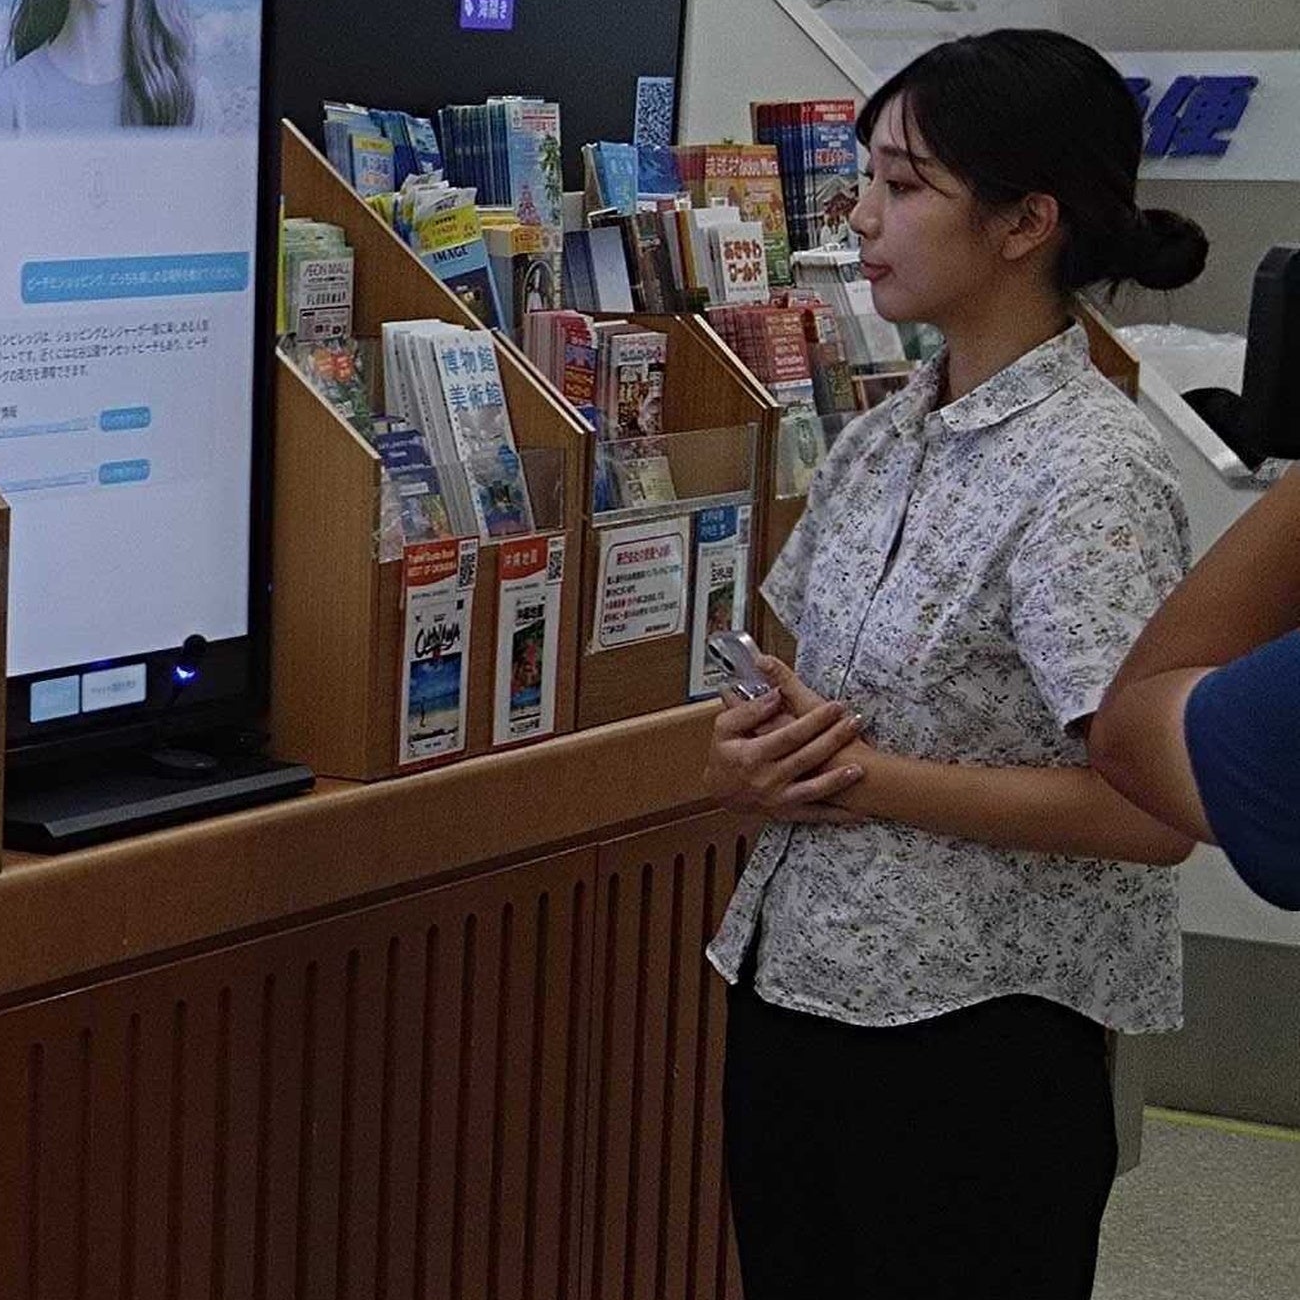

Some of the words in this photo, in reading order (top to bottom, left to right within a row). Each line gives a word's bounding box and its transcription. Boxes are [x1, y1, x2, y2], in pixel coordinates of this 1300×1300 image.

[1129, 75, 1259, 159] 便
[442, 345, 495, 376] 博物館
[449, 381, 504, 412] 美術館
